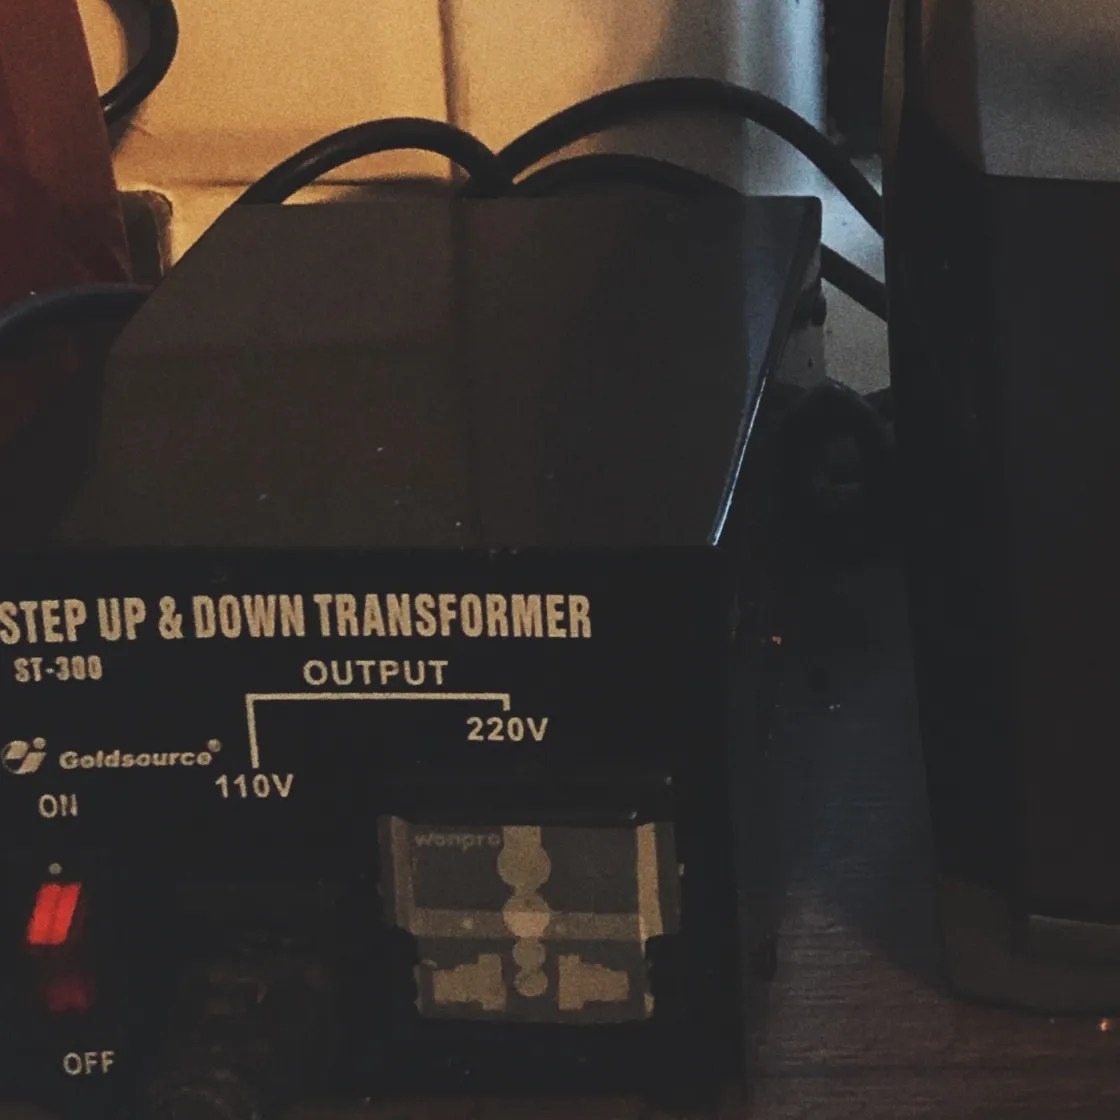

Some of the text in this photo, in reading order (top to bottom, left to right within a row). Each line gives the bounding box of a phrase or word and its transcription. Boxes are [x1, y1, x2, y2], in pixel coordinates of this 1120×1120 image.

[0, 593, 592, 645] STEP UP & DOWN TRANSFORMER
[14, 655, 103, 683] ST-300
[303, 659, 449, 686] OUTPUT
[466, 717, 549, 742] 220V
[59, 749, 213, 770] Goldsource
[215, 773, 294, 799] 110V
[38, 793, 78, 819] ON
[63, 1050, 115, 1076] OFF
